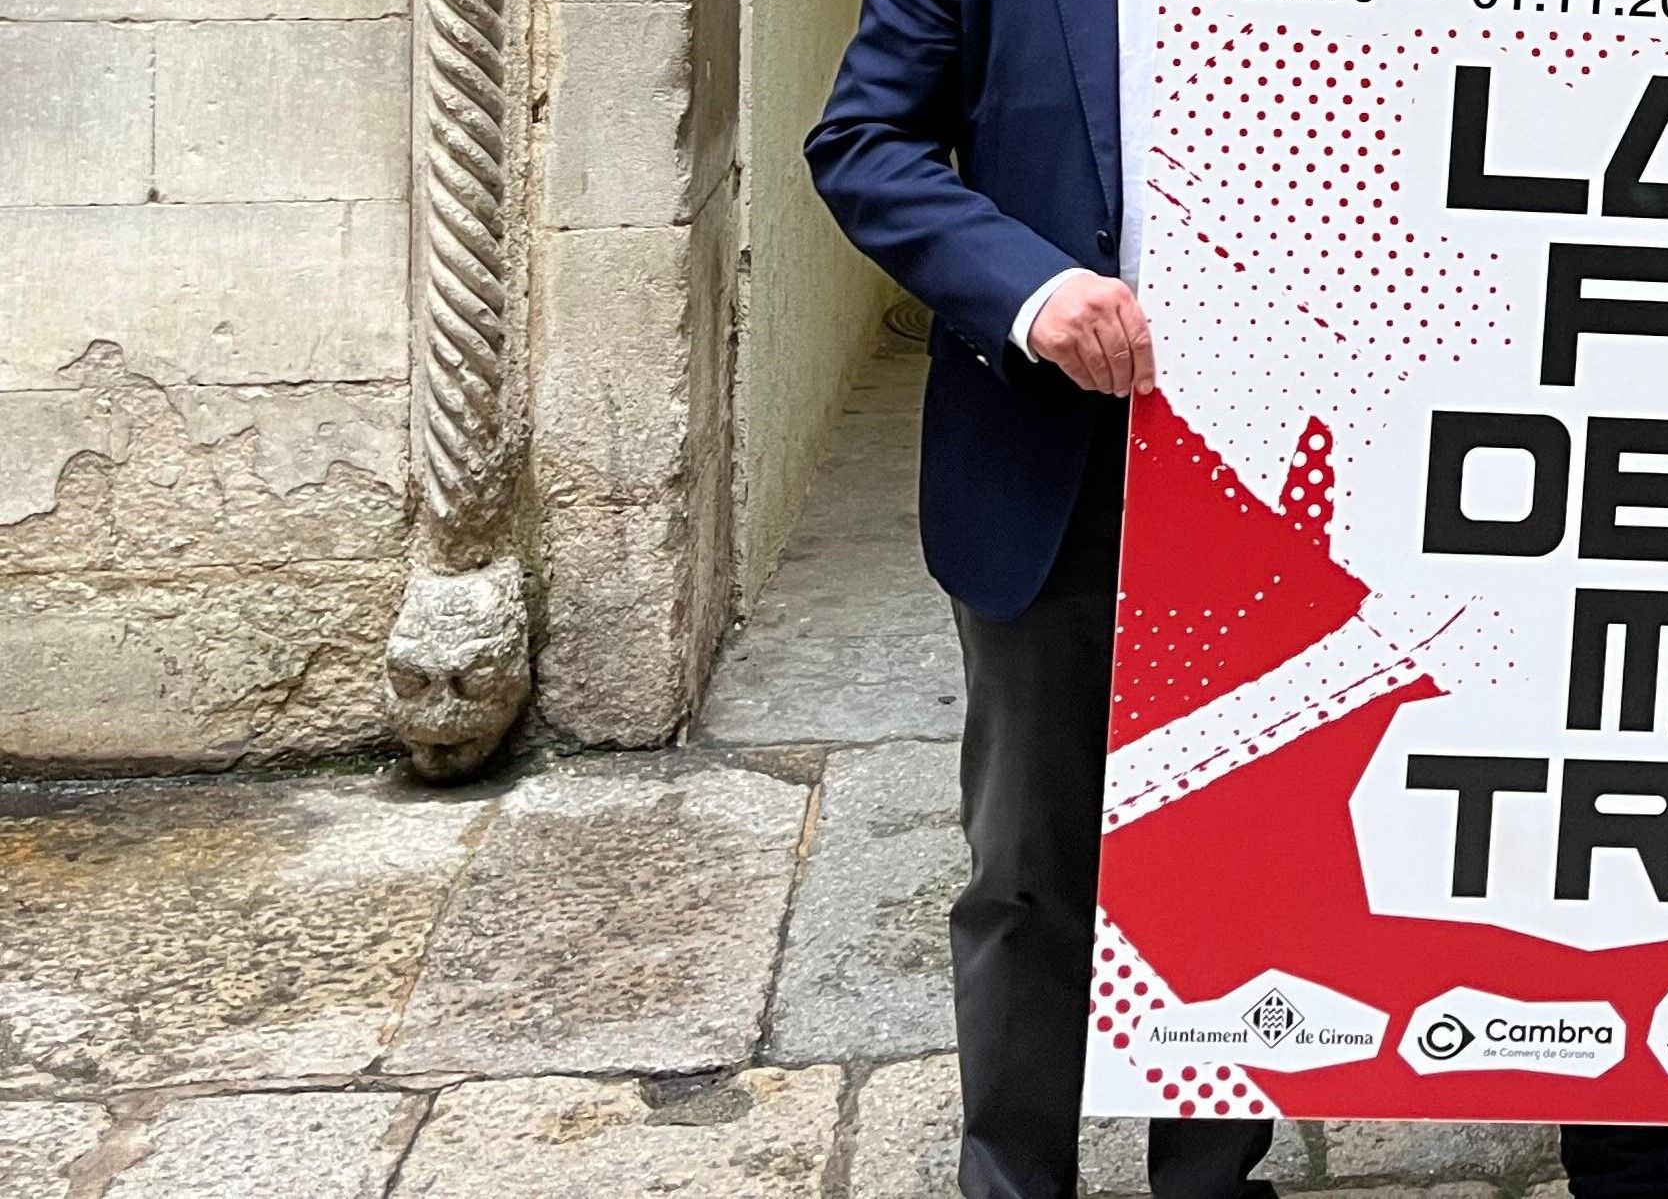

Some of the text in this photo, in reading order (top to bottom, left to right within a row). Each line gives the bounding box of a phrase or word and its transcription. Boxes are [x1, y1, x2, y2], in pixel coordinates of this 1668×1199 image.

[1149, 1026, 1374, 1046] Ajuntament de Girona
[1485, 1018, 1613, 1044] Cambra
[1483, 1048, 1595, 1060] de Comerç de Girona
